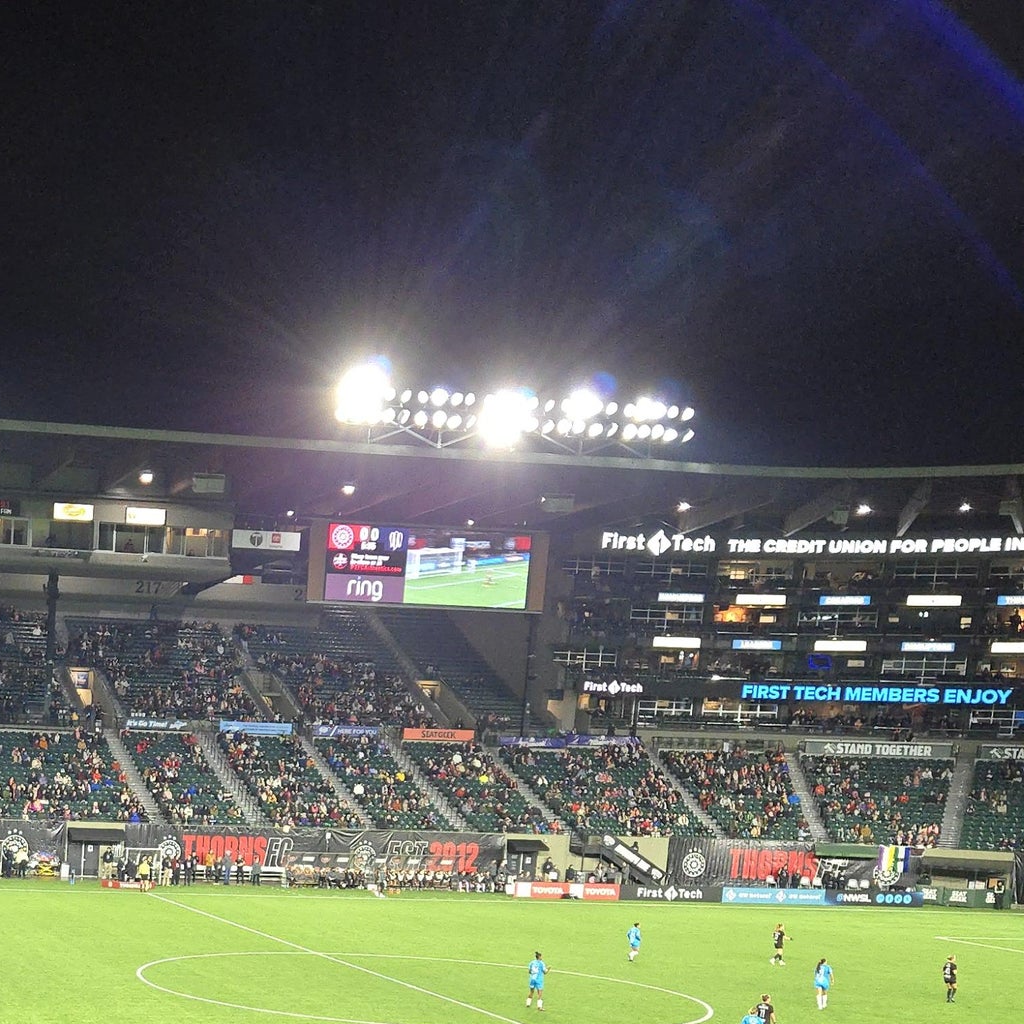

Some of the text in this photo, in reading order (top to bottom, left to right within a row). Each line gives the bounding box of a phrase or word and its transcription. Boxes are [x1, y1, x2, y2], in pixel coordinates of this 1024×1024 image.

[601, 532, 716, 552] First Tech
[728, 539, 762, 553] THE
[763, 539, 826, 553] CREDIT
[829, 539, 887, 554] UNION
[890, 539, 928, 554] FOR
[931, 538, 1002, 553] PEOPLE
[135, 581, 162, 594] 217
[346, 575, 384, 602] ring
[583, 681, 643, 693] First Tech
[741, 684, 1013, 705] FIRST TECH MEMBERS ENJOY
[835, 743, 932, 757] STAND TOGETHER
[182, 835, 294, 868] THORNS FC
[426, 840, 480, 873] 2012
[533, 886, 564, 895] TOYOTA
[585, 888, 616, 897] TOYOTA
[637, 887, 703, 900] First Tech
